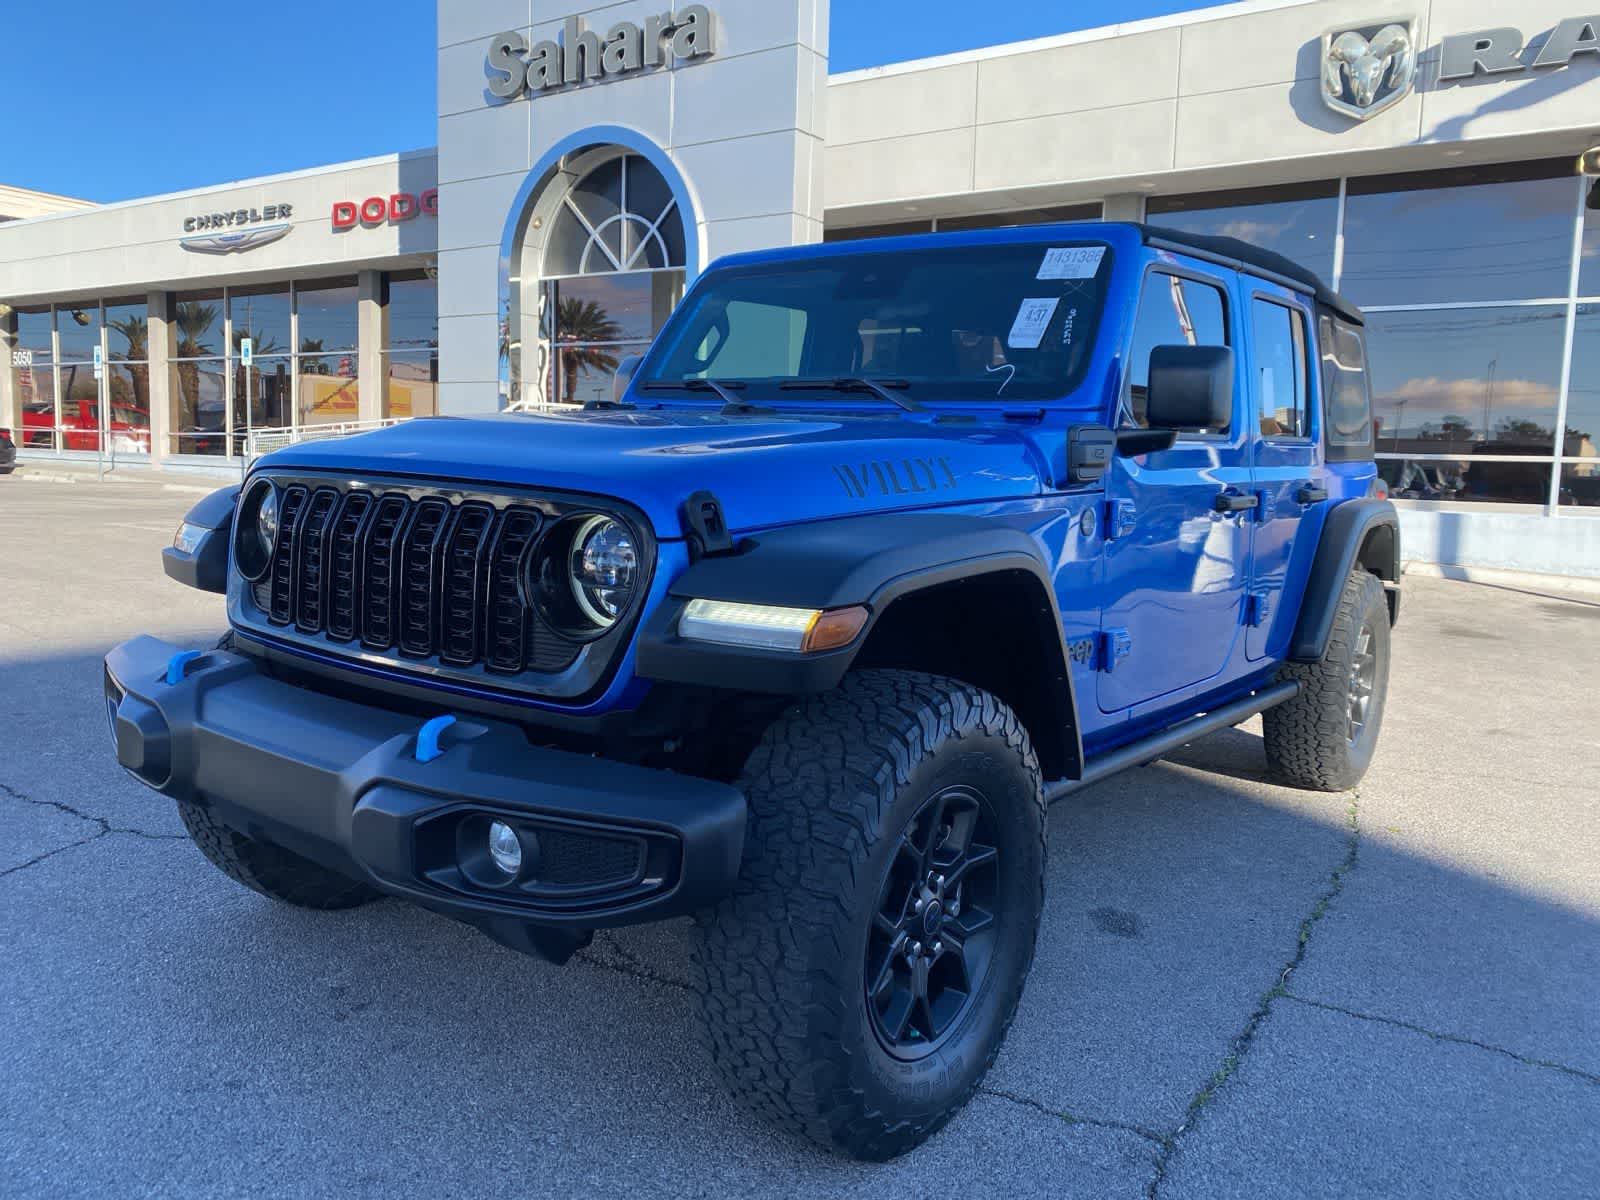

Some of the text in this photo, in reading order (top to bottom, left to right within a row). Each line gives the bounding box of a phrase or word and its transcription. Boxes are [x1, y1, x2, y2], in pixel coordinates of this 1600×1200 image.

[487, 3, 715, 100] Sahara
[183, 203, 293, 232] CHRYSLER
[13, 351, 32, 366] 5050
[831, 456, 957, 498] WILLYS
